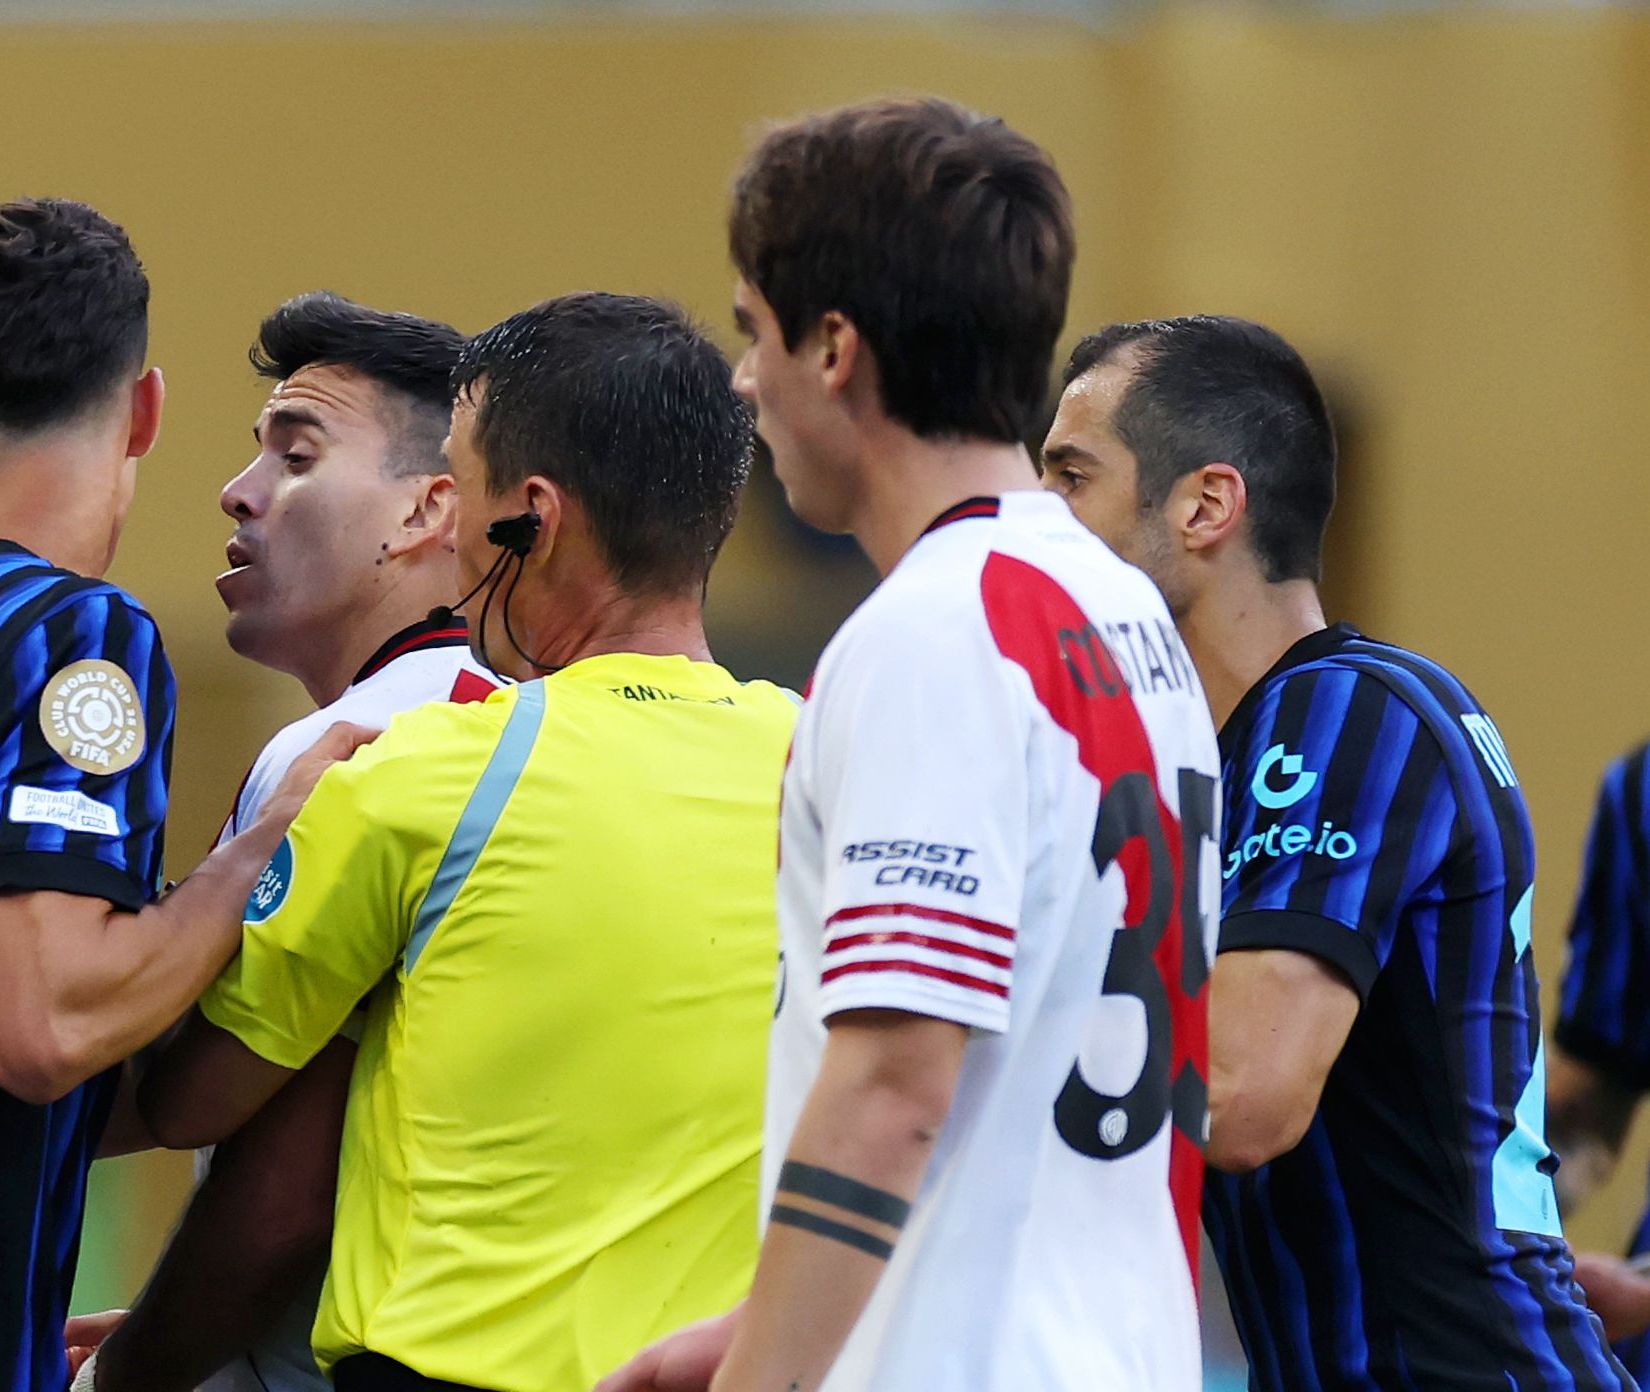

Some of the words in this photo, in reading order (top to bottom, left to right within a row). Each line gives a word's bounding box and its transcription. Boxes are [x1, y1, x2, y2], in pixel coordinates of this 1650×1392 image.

[57, 671, 108, 698] WORLD
[109, 677, 132, 704] CUP
[51, 699, 69, 738] CLUB
[69, 740, 112, 767] FIFA
[841, 840, 977, 867] ASSIST
[875, 866, 981, 896] CARD
